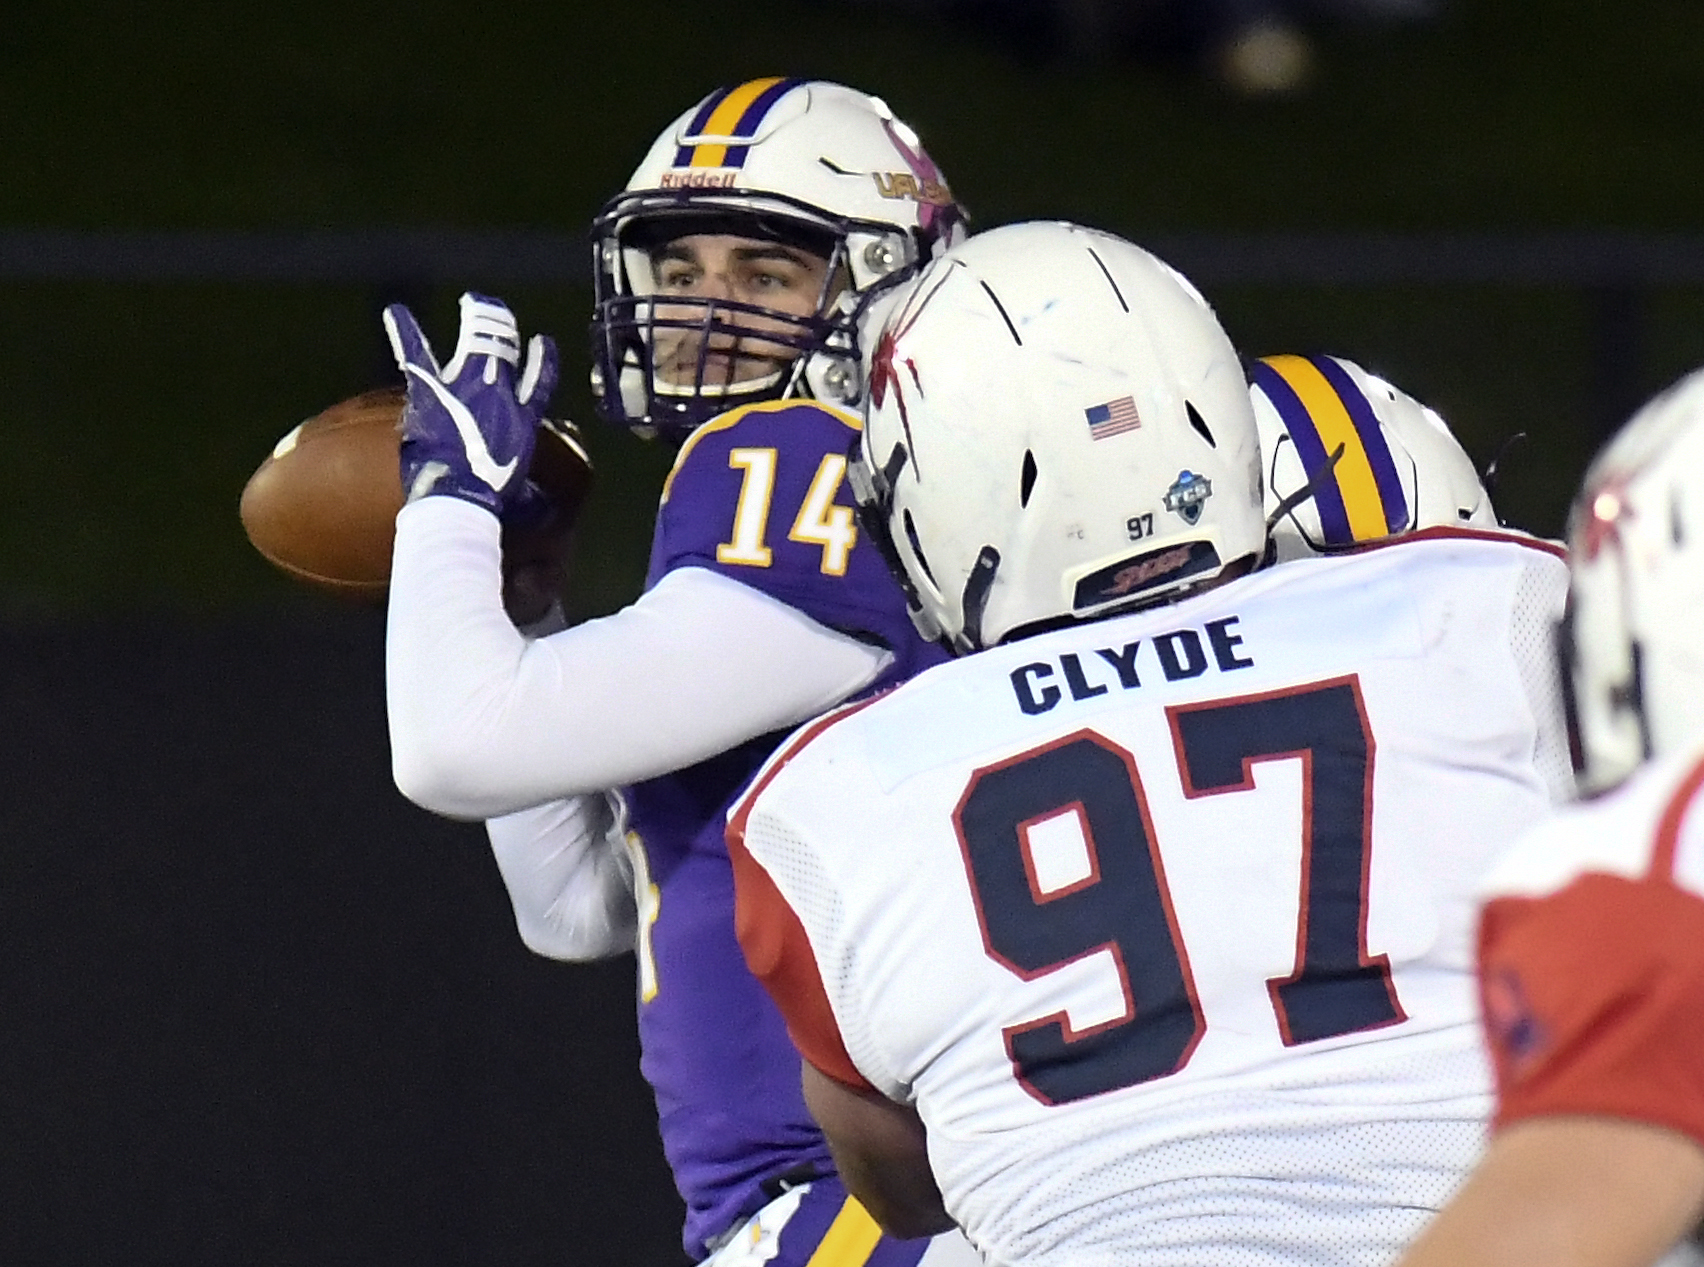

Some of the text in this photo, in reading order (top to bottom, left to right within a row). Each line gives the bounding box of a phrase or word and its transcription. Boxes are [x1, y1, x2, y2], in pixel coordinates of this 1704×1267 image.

[661, 172, 737, 188] Riddell
[716, 447, 858, 577] 14
[1126, 512, 1154, 541] 97
[1010, 615, 1254, 716] CLYDE
[951, 673, 1410, 1107] 97
